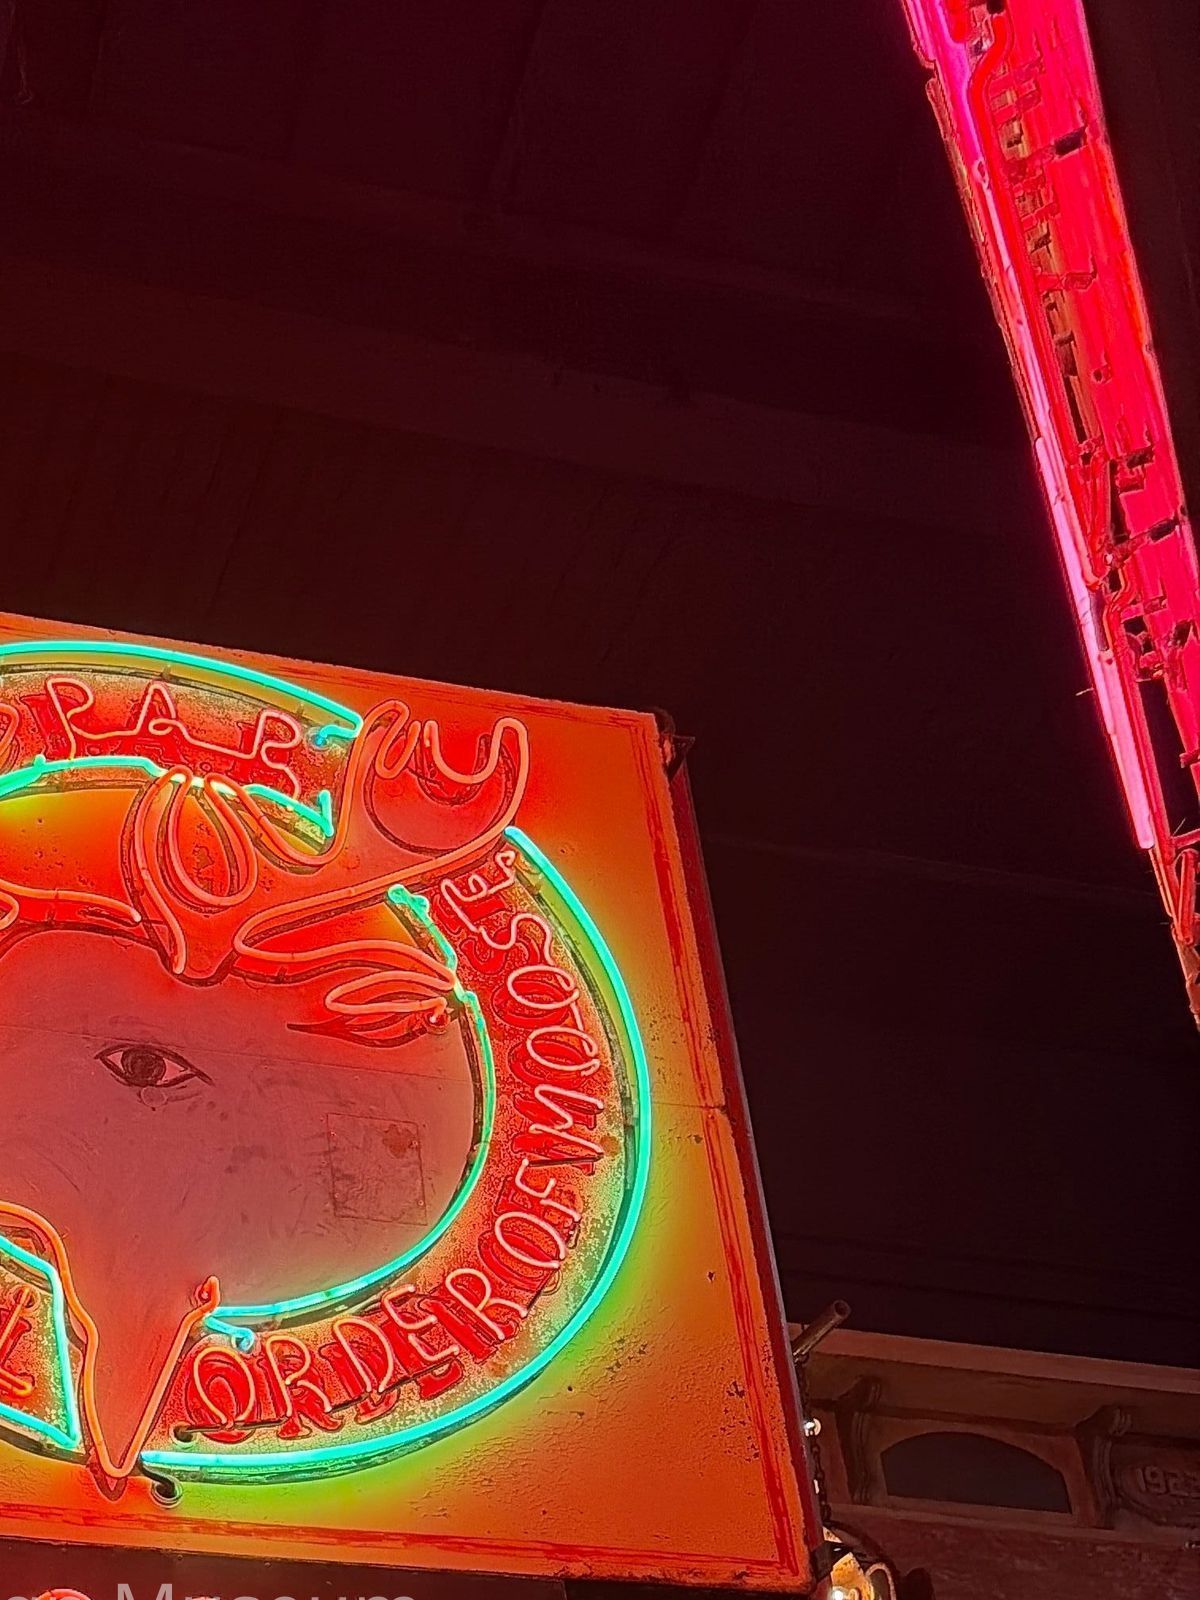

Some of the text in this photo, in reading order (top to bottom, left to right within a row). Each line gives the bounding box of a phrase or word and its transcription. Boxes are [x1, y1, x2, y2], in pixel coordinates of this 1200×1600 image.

[434, 850, 604, 1176] MOOSE
[477, 1160, 584, 1293] OF
[185, 1268, 529, 1443] ORDER
